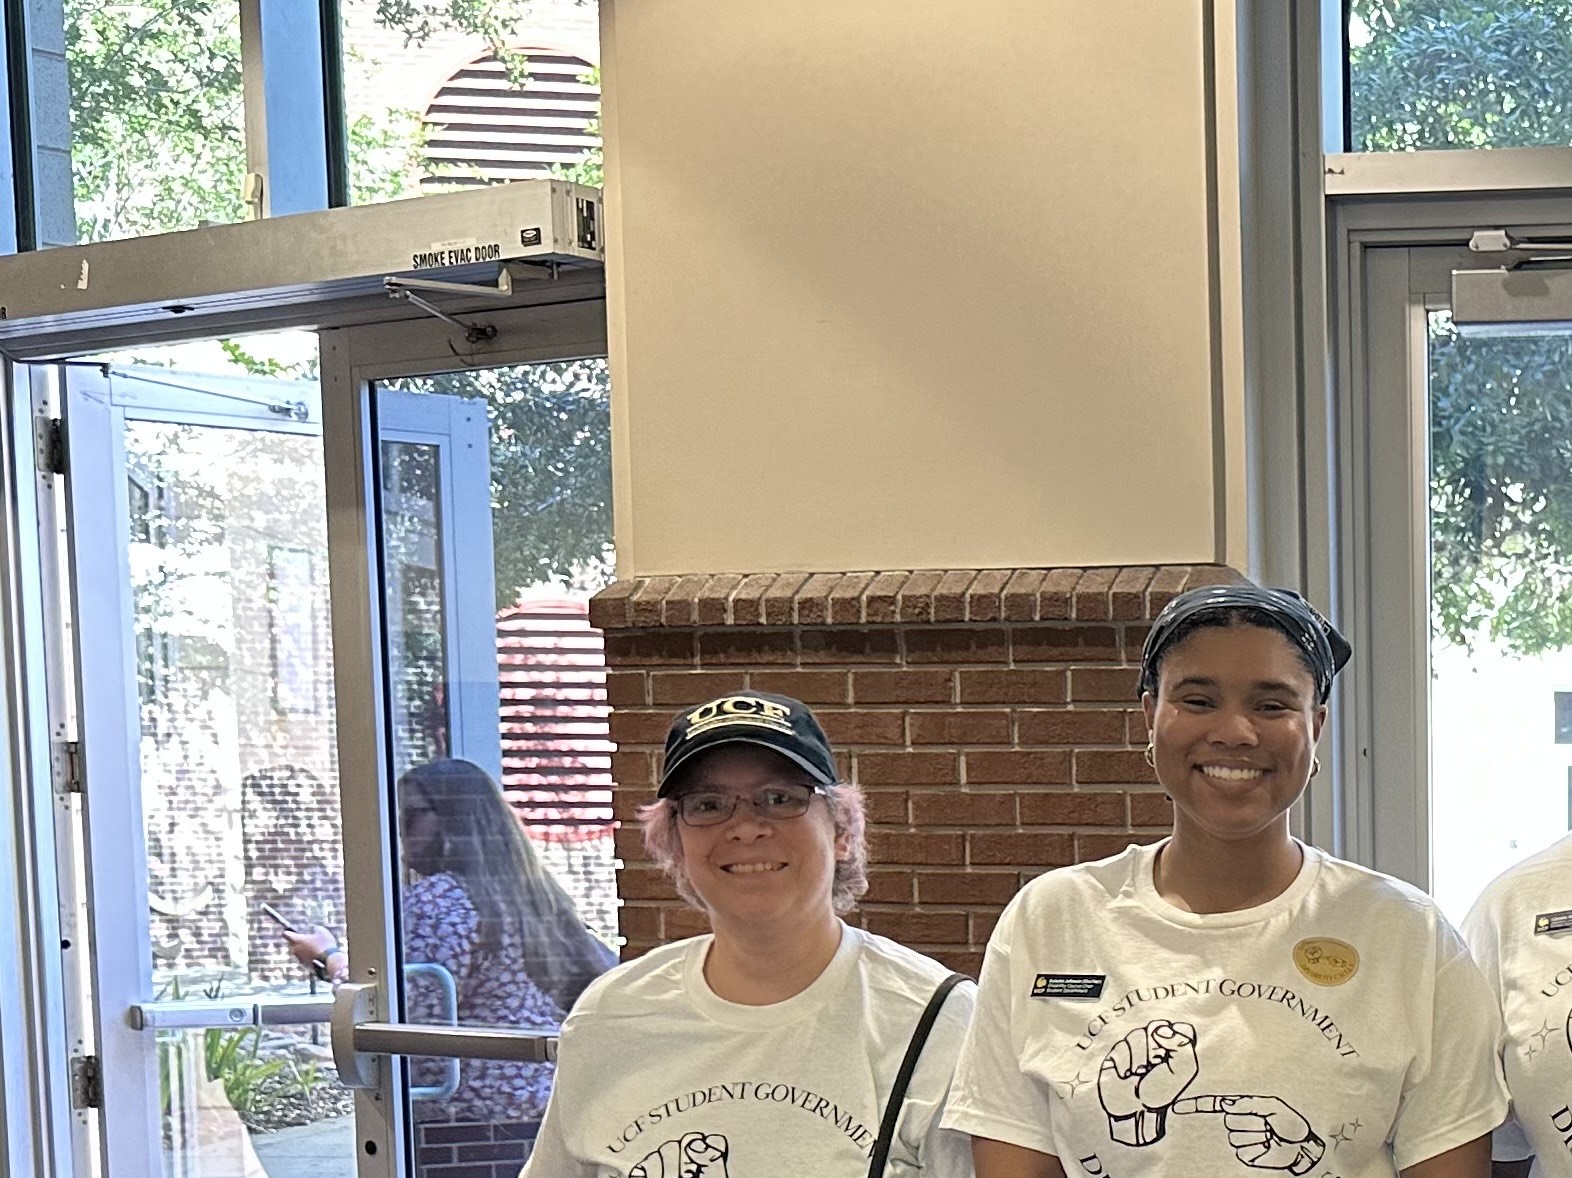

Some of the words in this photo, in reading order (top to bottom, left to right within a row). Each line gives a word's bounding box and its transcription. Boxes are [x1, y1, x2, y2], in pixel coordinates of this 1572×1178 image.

[413, 252, 446, 270] SMOKE
[449, 247, 472, 265] EVAC
[475, 244, 500, 262] DOOR
[686, 696, 791, 725] UCF
[1076, 1011, 1109, 1052] UCF
[1112, 979, 1218, 1018] STUDENT
[1219, 979, 1360, 1059] GOVERNMENT
[606, 1115, 646, 1153] UCF
[648, 1082, 752, 1125] STUDENT
